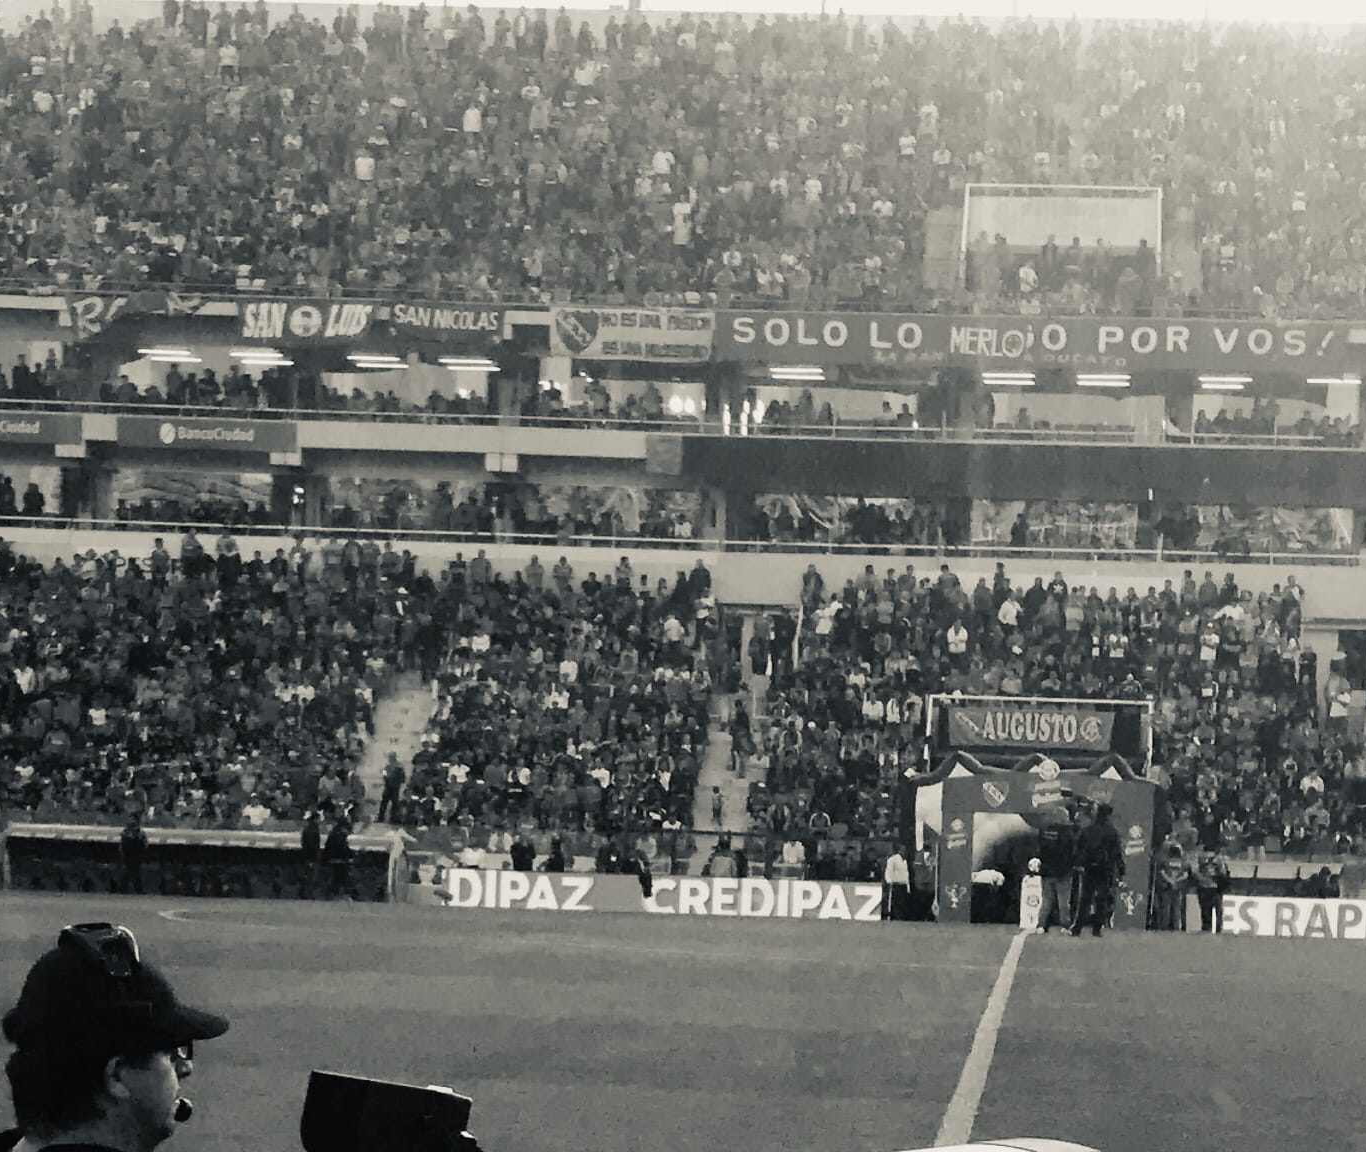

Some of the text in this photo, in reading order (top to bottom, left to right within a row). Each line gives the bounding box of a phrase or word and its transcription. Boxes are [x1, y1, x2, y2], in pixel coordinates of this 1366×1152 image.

[242, 302, 288, 338] SAN
[393, 303, 499, 331] SAN NICOLAS
[732, 317, 848, 347] SOLO
[869, 320, 923, 349] LO
[1097, 325, 1191, 355] POR
[1214, 326, 1334, 357] VOS!
[949, 325, 1025, 358] MERLO
[982, 711, 1079, 743] AUGUSTO
[642, 877, 883, 921] CREDIPAZ
